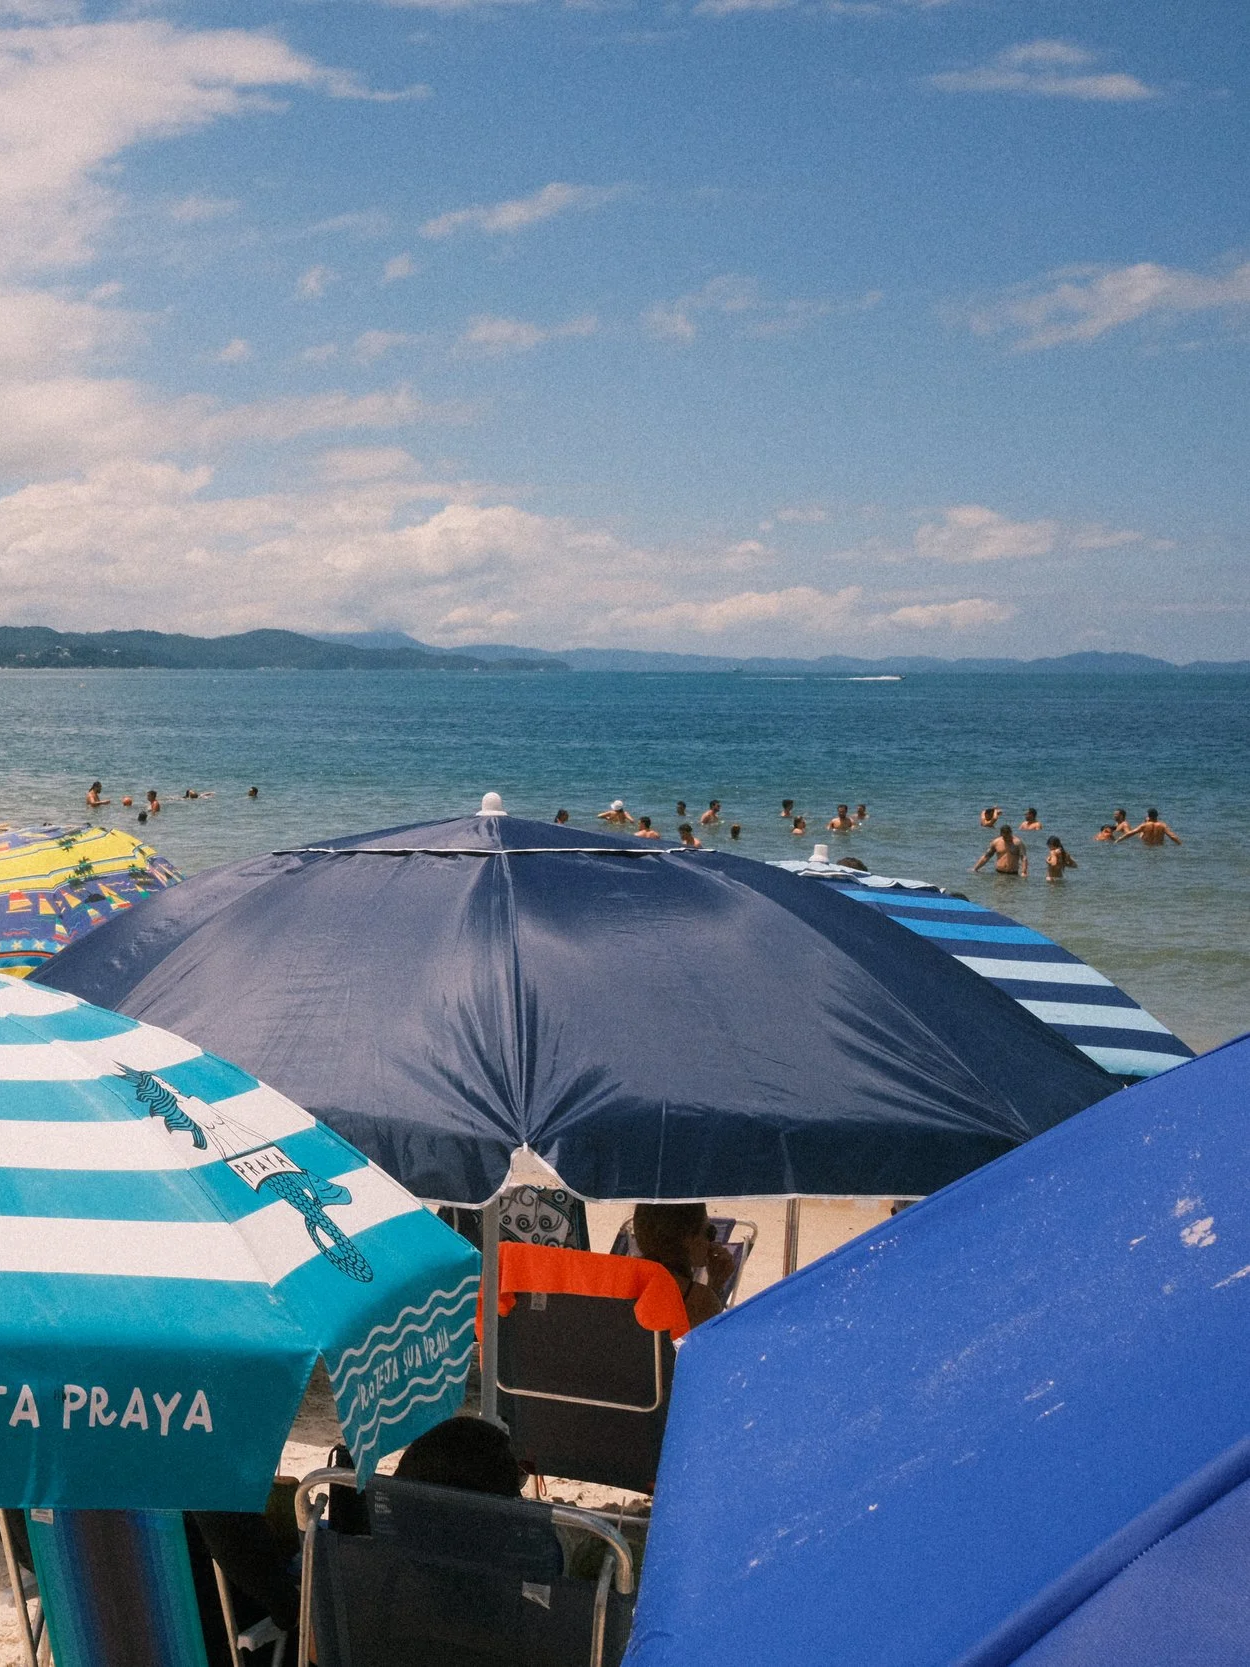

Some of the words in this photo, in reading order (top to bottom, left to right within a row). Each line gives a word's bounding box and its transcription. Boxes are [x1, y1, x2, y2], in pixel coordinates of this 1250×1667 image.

[233, 1152, 294, 1184] PRAYA
[403, 1344, 423, 1376] SUA
[62, 1384, 214, 1436] PRAYA
